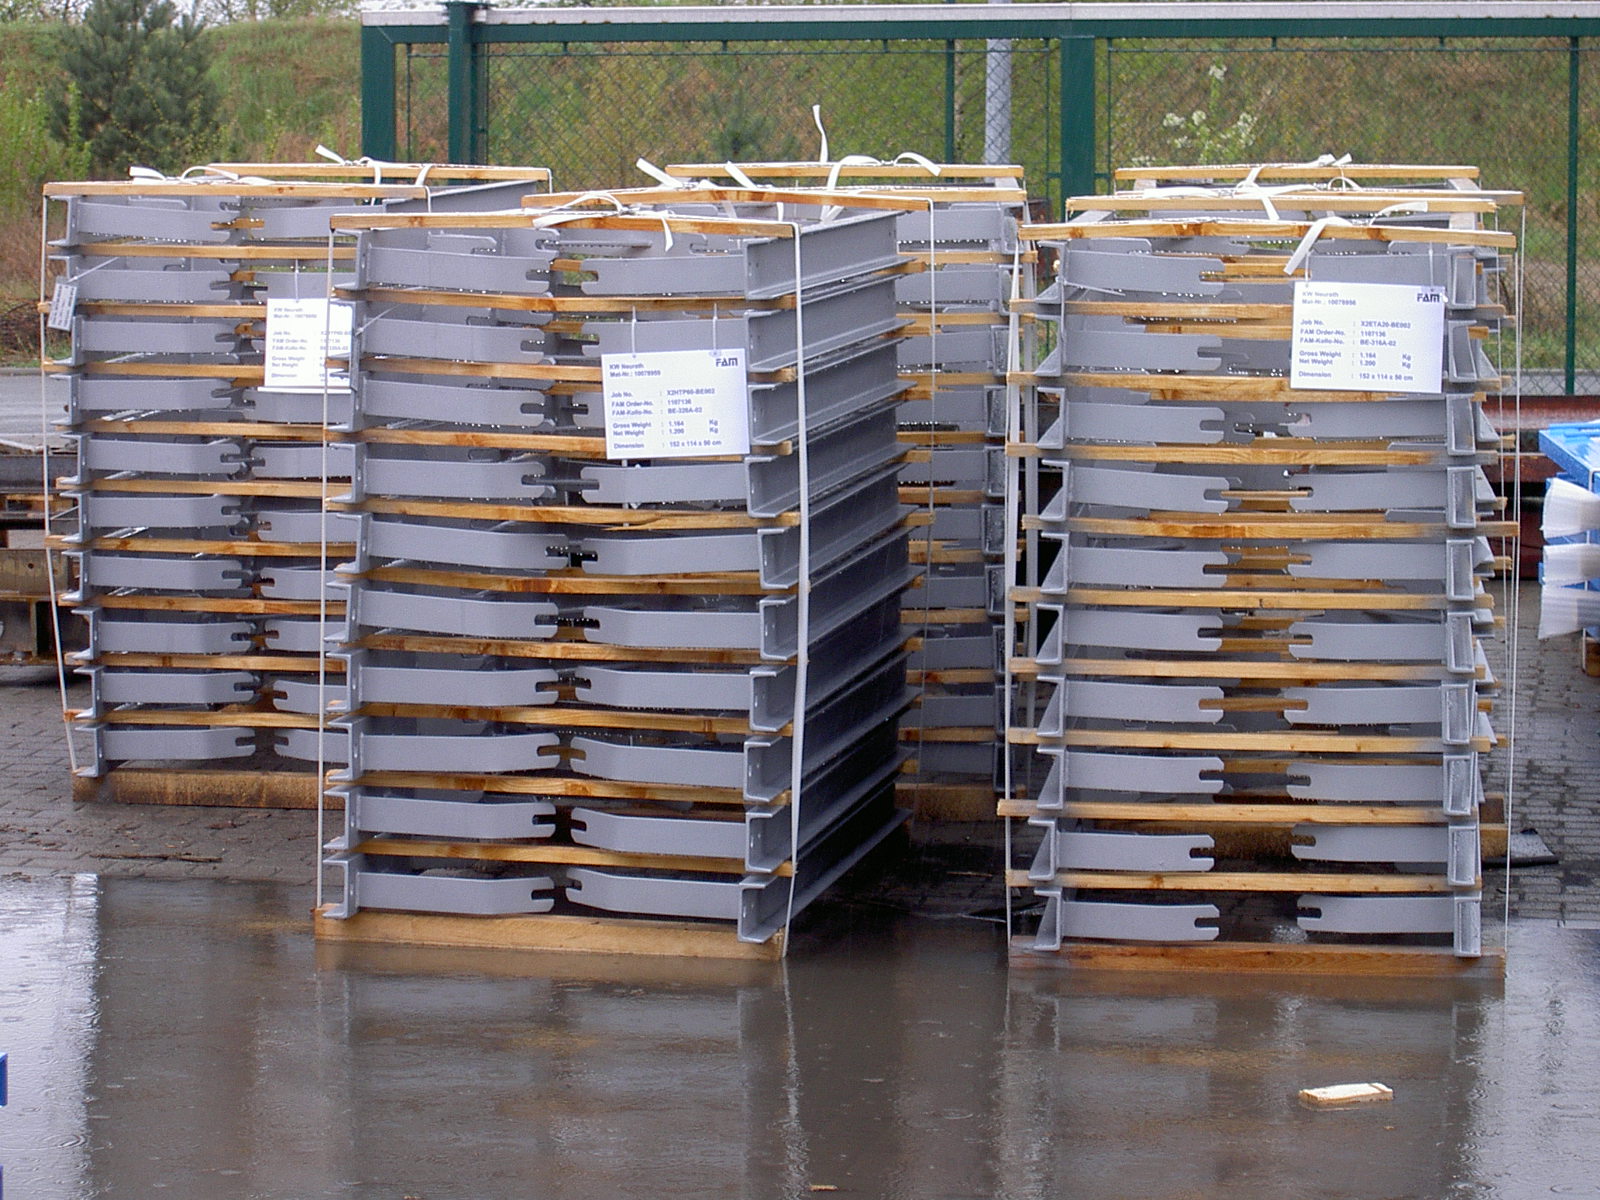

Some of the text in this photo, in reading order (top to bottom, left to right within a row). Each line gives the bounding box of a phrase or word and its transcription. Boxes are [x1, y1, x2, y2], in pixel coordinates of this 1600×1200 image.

[1417, 293, 1440, 303] FAM
[715, 357, 738, 367] FAM
[1299, 370, 1332, 378] Dimension
[613, 442, 645, 450] Dimension
